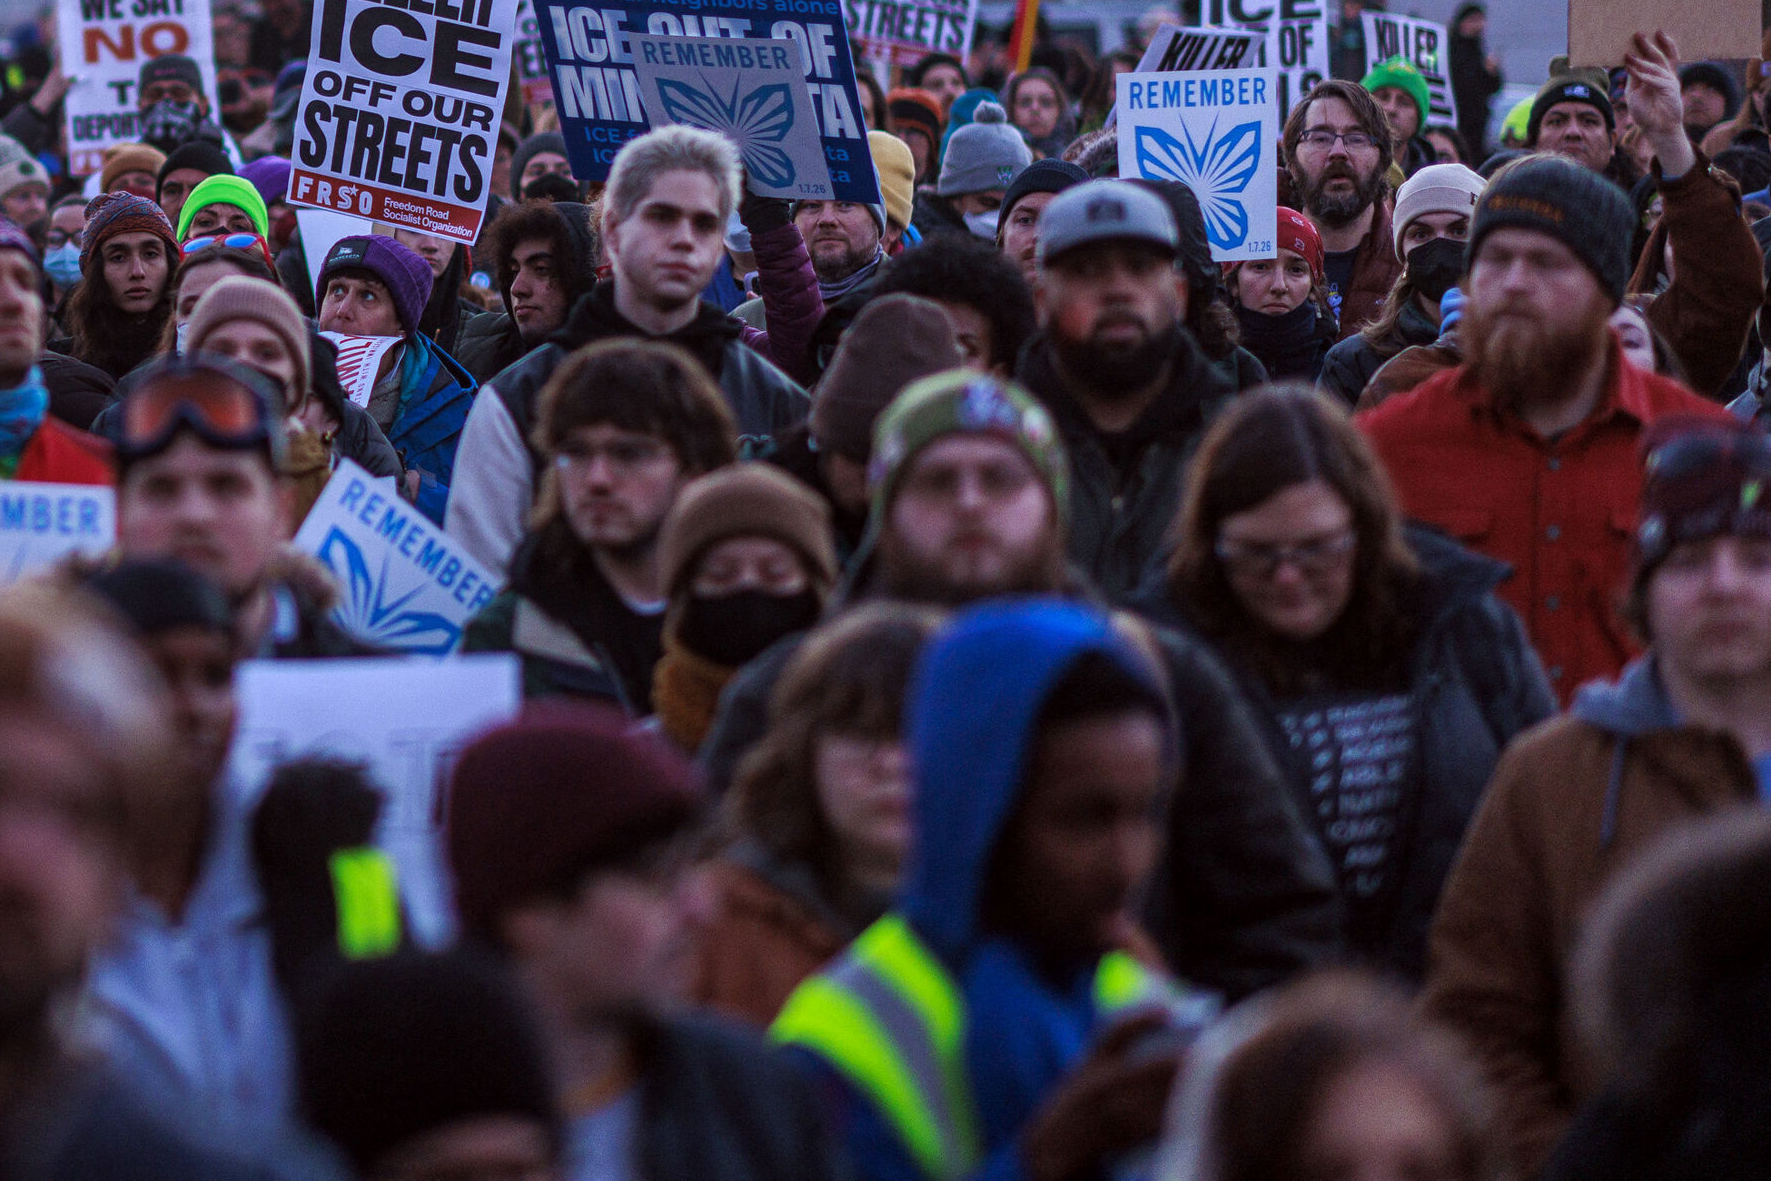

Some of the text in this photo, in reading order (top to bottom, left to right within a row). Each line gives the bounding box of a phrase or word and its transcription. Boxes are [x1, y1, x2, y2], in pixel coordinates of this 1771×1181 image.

[84, 21, 190, 65] NO
[548, 5, 633, 65] ICE
[1155, 31, 1251, 72] KILLER
[1279, 23, 1314, 68] OF
[640, 40, 791, 70] REMEMBER
[108, 81, 134, 105] T
[312, 69, 495, 133] OFF OUR
[1129, 76, 1267, 110] REMEMBER
[299, 99, 488, 204] STREETS
[584, 126, 623, 144] ICE
[296, 175, 374, 215] FRSO
[797, 183, 826, 195] 1.7.26
[382, 208, 474, 238] Socialist Organization
[383, 196, 450, 221] Freedom Road
[1247, 240, 1272, 254] 1.7.26
[336, 476, 497, 615] REMEMBER
